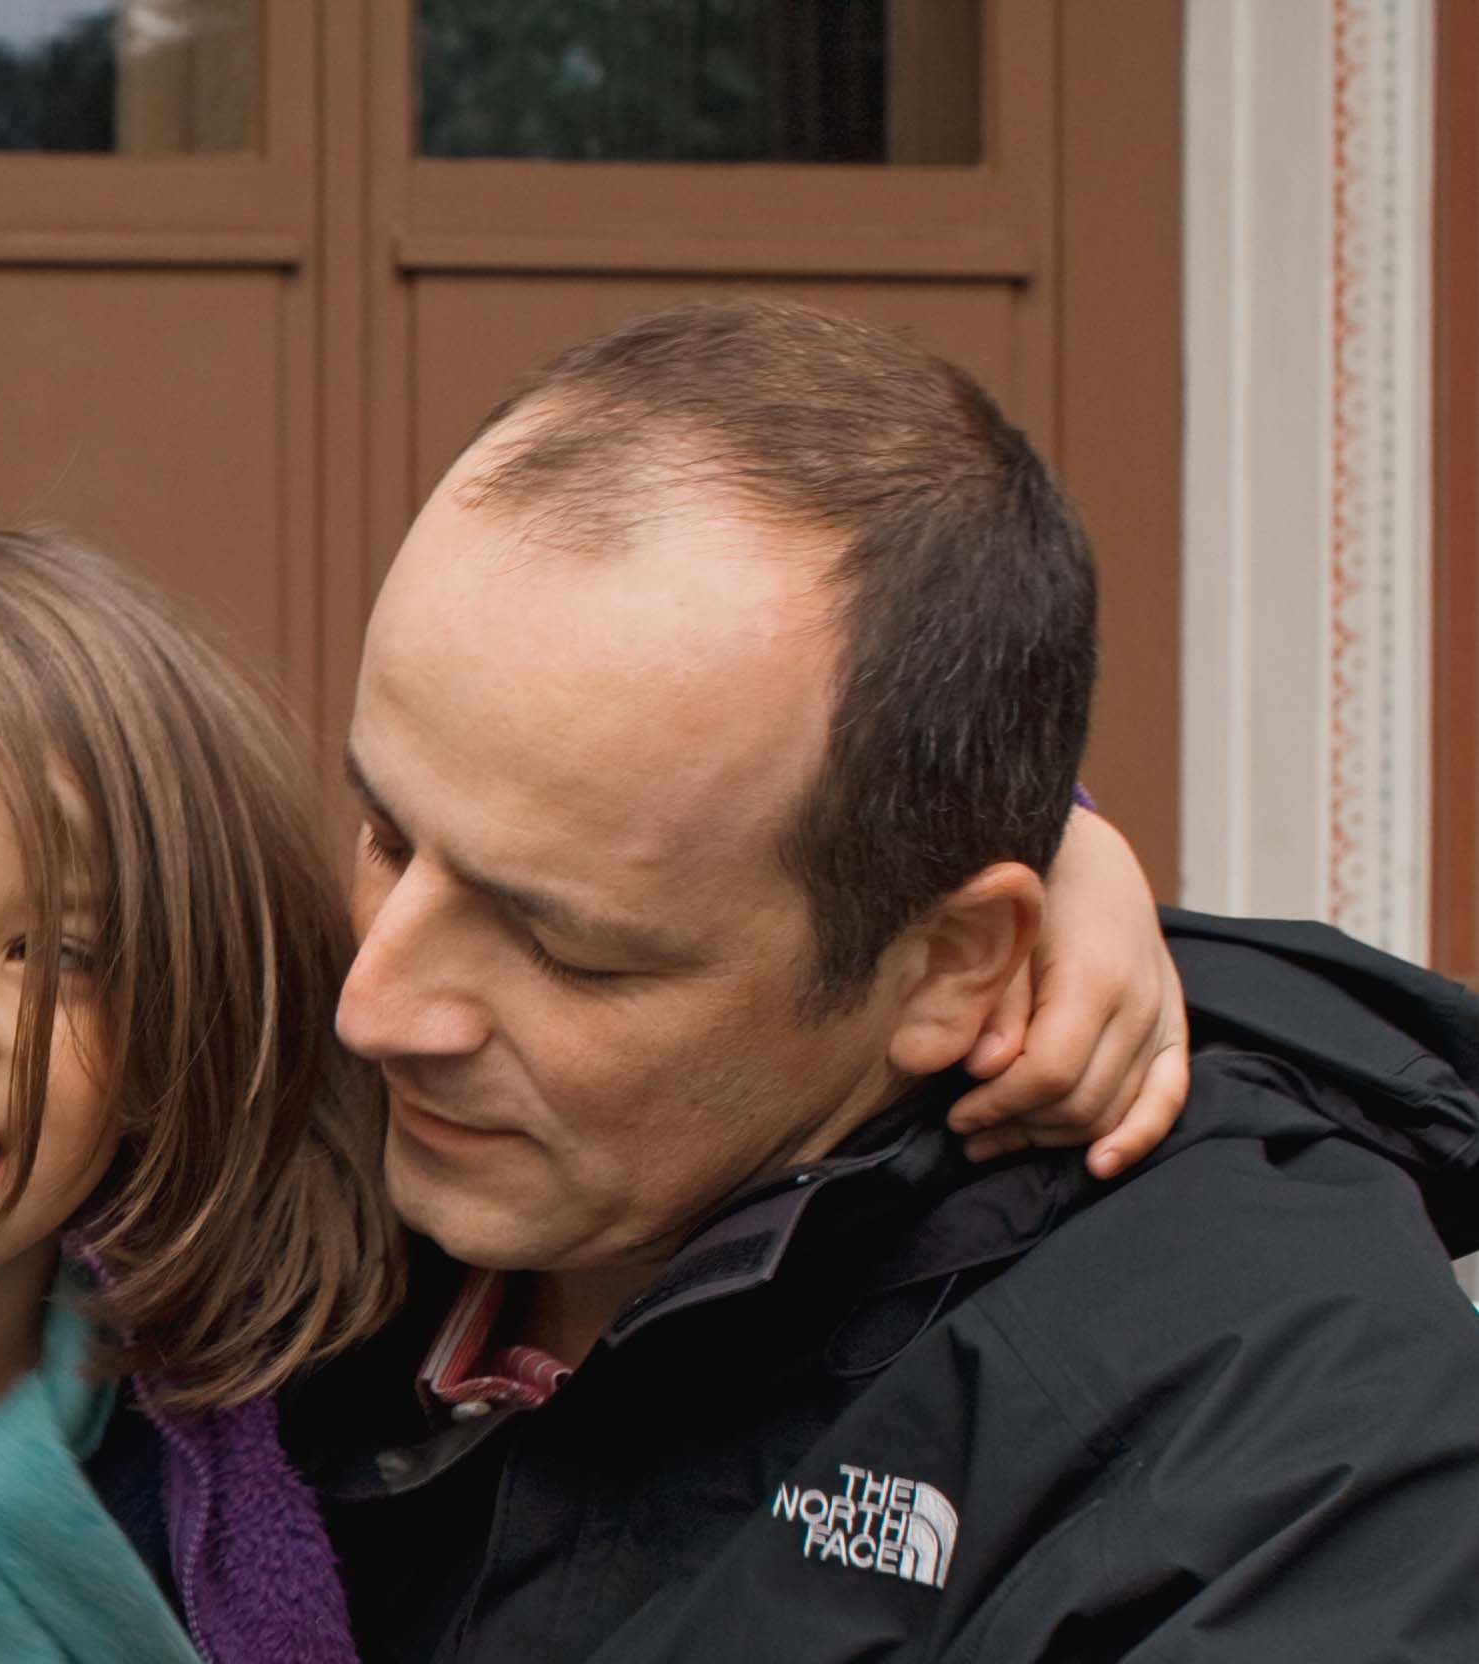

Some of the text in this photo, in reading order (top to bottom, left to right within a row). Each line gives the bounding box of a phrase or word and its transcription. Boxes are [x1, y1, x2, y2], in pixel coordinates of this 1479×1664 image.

[839, 1463, 915, 1512] THE
[772, 1482, 910, 1550] NORTH
[803, 1522, 898, 1575] FACE
